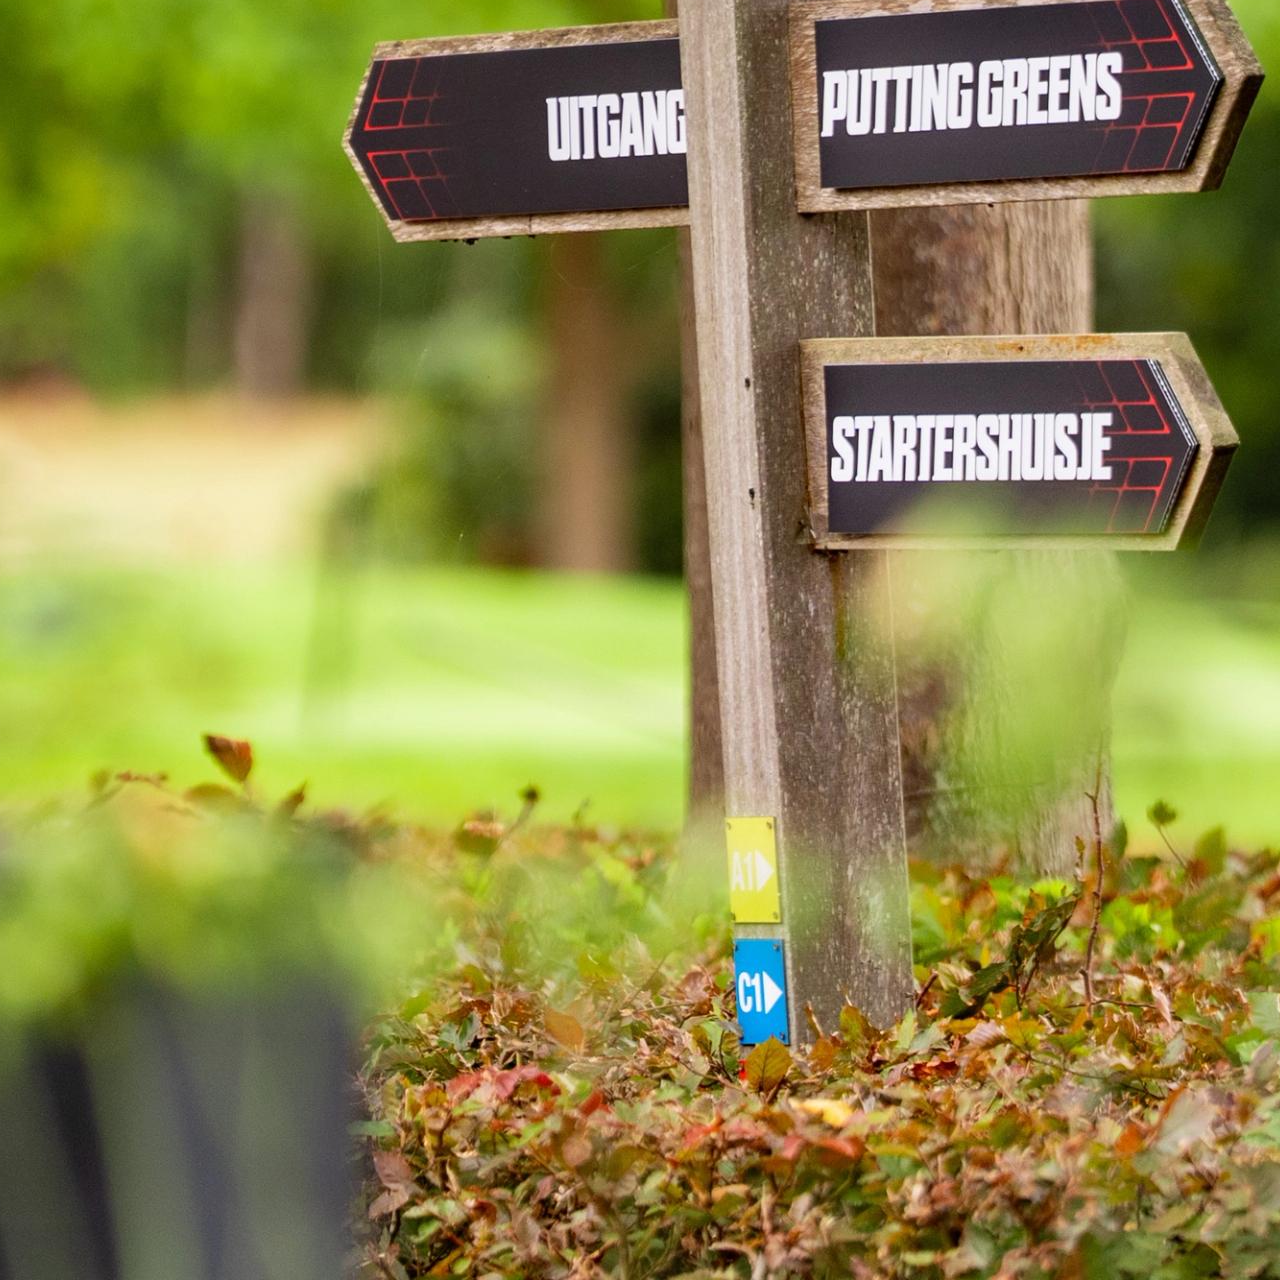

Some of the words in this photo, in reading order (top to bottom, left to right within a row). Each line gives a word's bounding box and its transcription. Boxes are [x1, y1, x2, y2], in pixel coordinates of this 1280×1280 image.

[545, 89, 687, 161] UITGANG
[820, 62, 973, 138] PUTTING
[978, 52, 1122, 127] GREENS
[831, 413, 1113, 483] STARTERSHUISJE
[731, 850, 754, 892] A1
[738, 971, 763, 1013] C1
